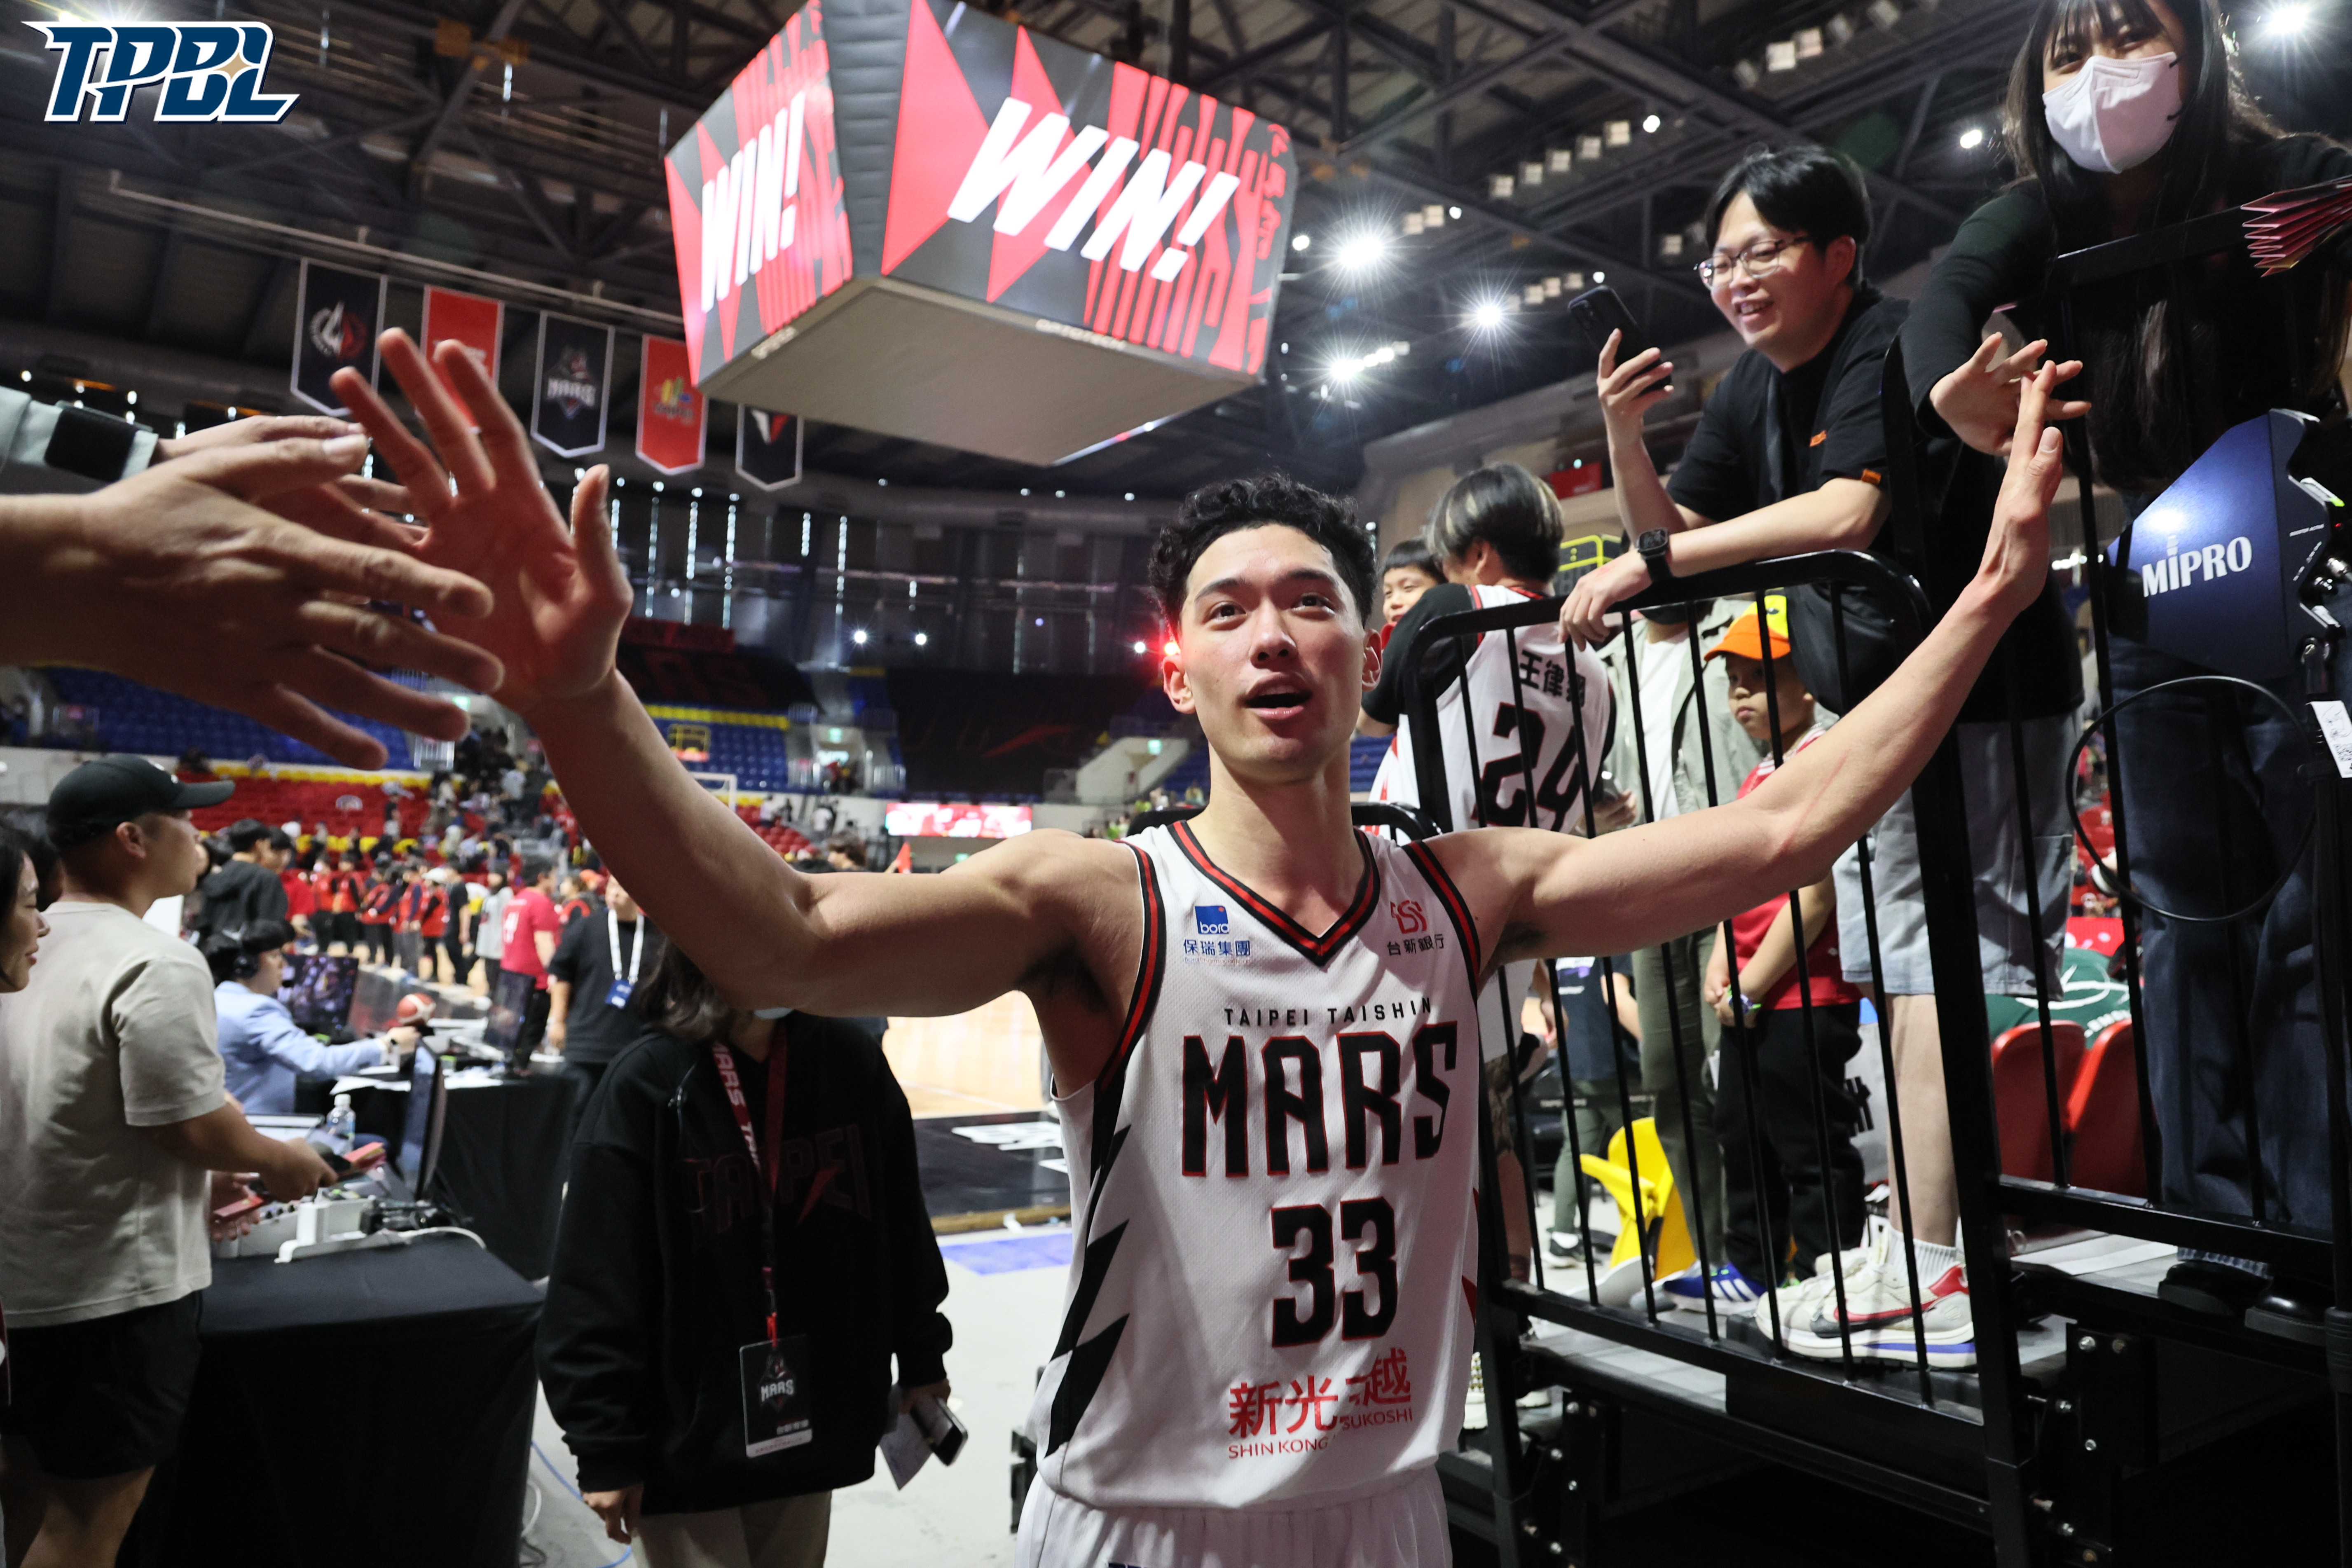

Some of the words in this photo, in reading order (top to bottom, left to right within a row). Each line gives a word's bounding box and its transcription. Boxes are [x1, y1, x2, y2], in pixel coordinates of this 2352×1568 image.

[701, 91, 806, 314] WIN!
[947, 96, 1240, 282] WIN!
[1471, 702, 1581, 832] 24
[1183, 938, 1251, 956] 保瑞集團
[1200, 921, 1229, 934] bora
[1387, 933, 1444, 956] 台新銀行
[1224, 1008, 1308, 1026] TAIPEI
[1327, 997, 1431, 1025] TAISHIN
[1182, 1020, 1458, 1177] MARS
[682, 1123, 873, 1240] TAPEI
[1271, 1196, 1397, 1348] 33
[761, 1379, 794, 1402] MARS
[1229, 1442, 1273, 1459] SHIN
[1278, 1436, 1329, 1454] KONG
